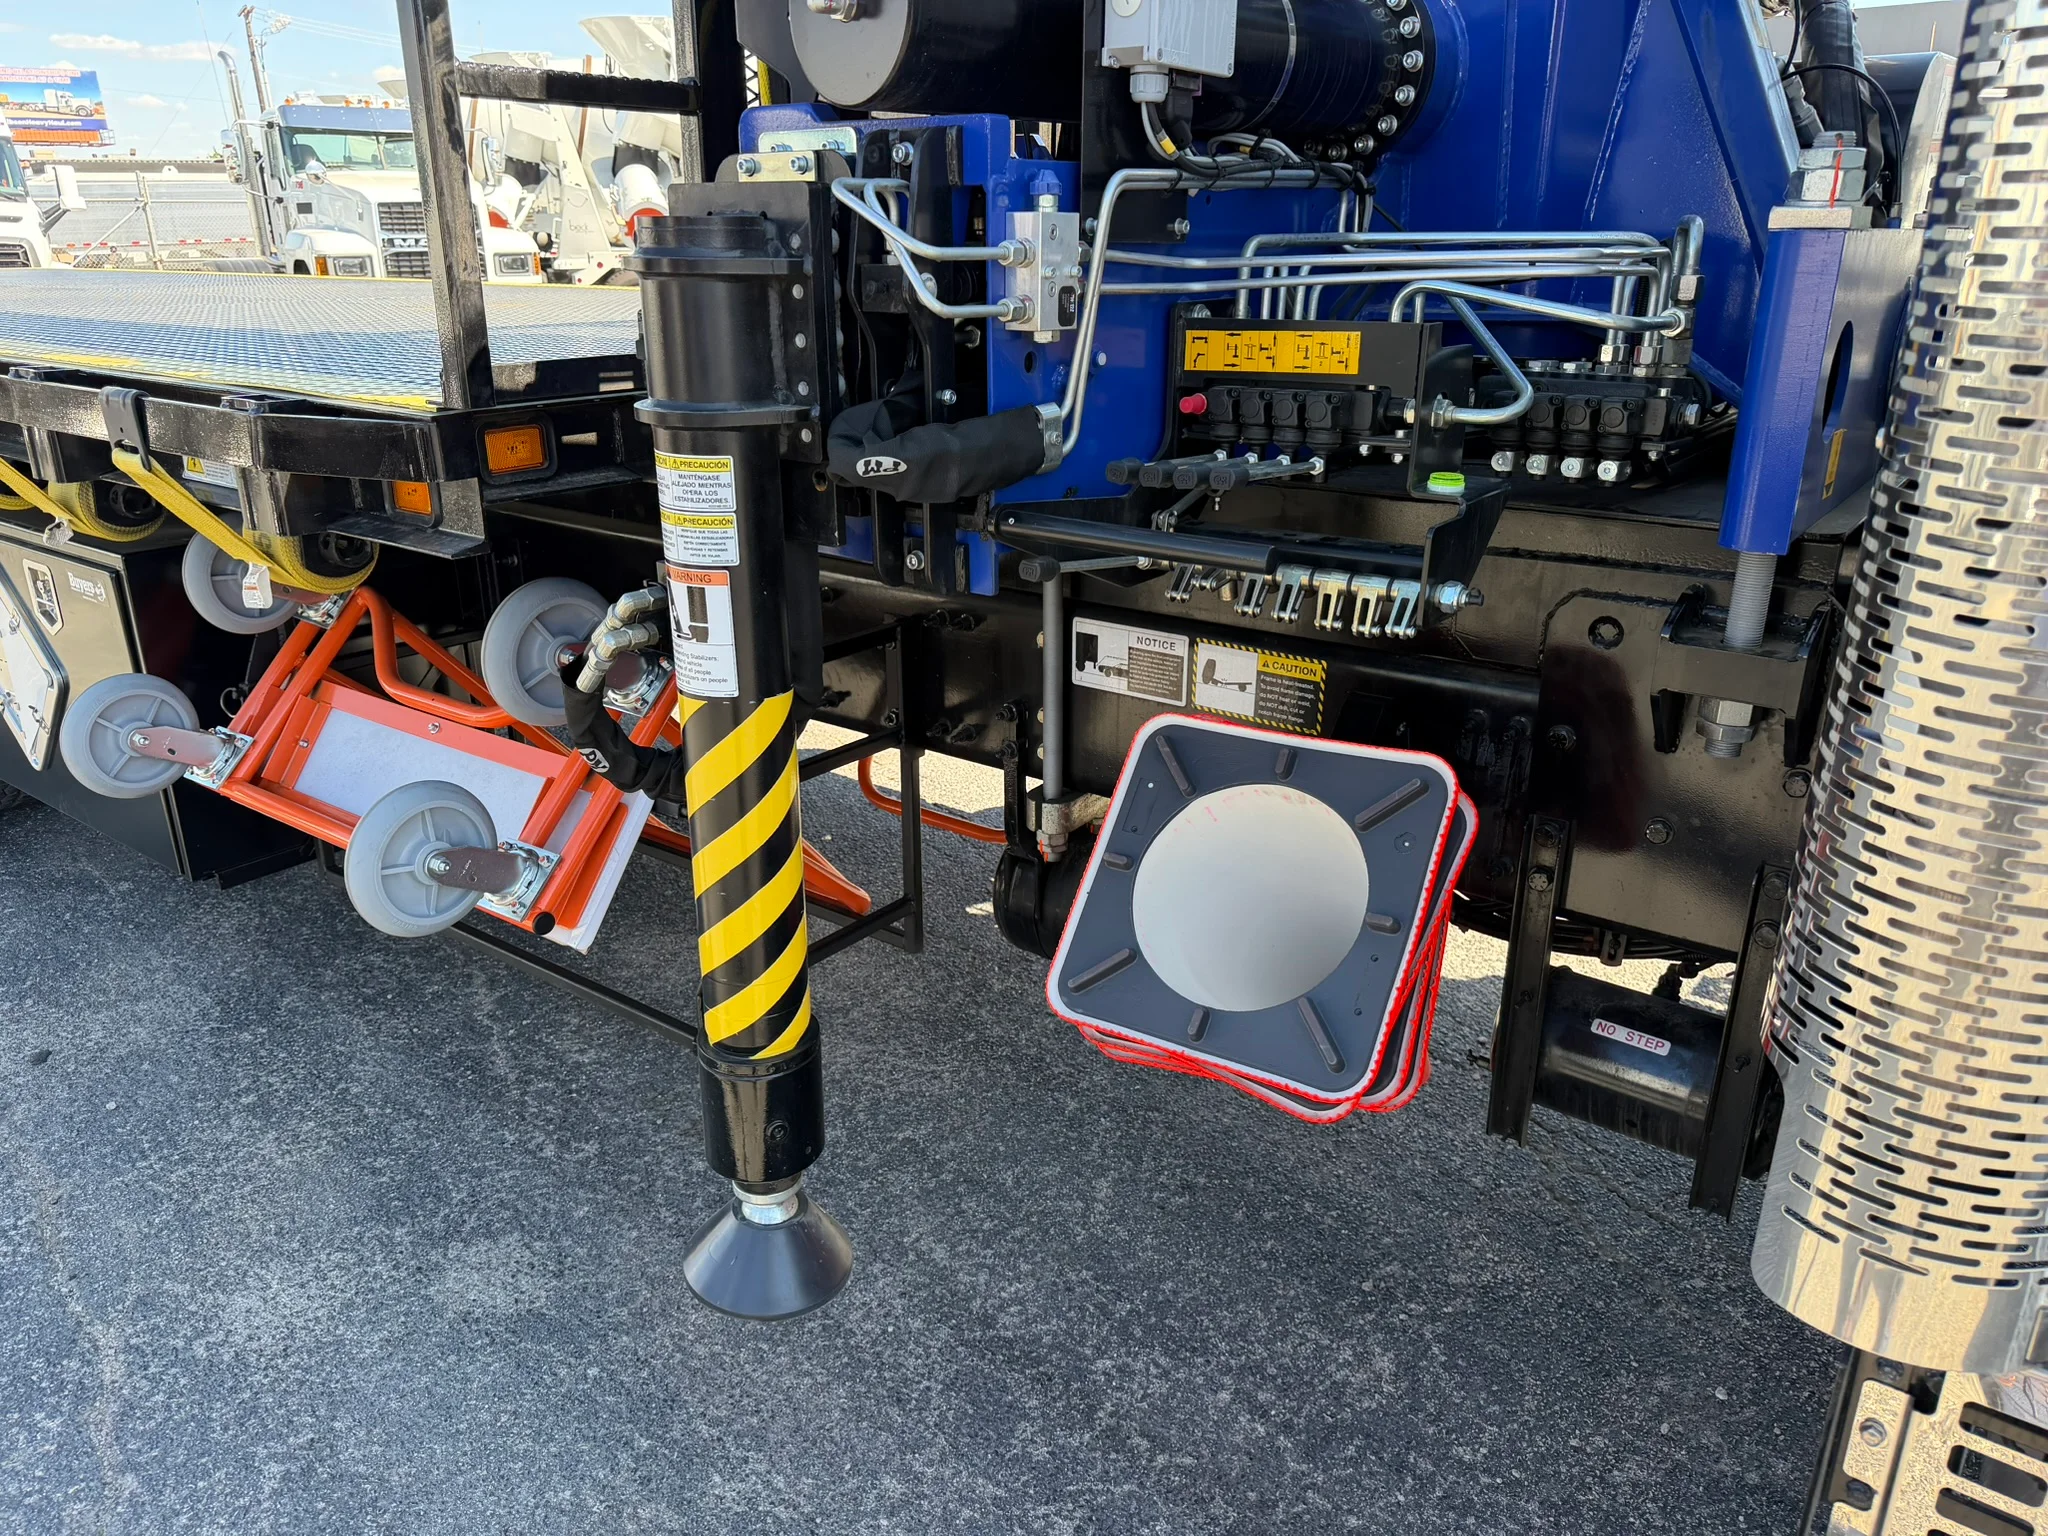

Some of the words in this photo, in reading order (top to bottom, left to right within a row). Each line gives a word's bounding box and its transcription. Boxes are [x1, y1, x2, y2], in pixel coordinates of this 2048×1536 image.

[680, 460, 729, 469] PRECAUCIÓN
[678, 473, 720, 481] MANTÉNGASE
[683, 517, 733, 526] PRECAUCIÓN
[672, 570, 712, 583] WARNING
[1136, 636, 1176, 651] NOTICE
[1272, 661, 1317, 677] CAUTION
[1596, 1021, 1617, 1036] NO
[1625, 1031, 1665, 1051] STEP
